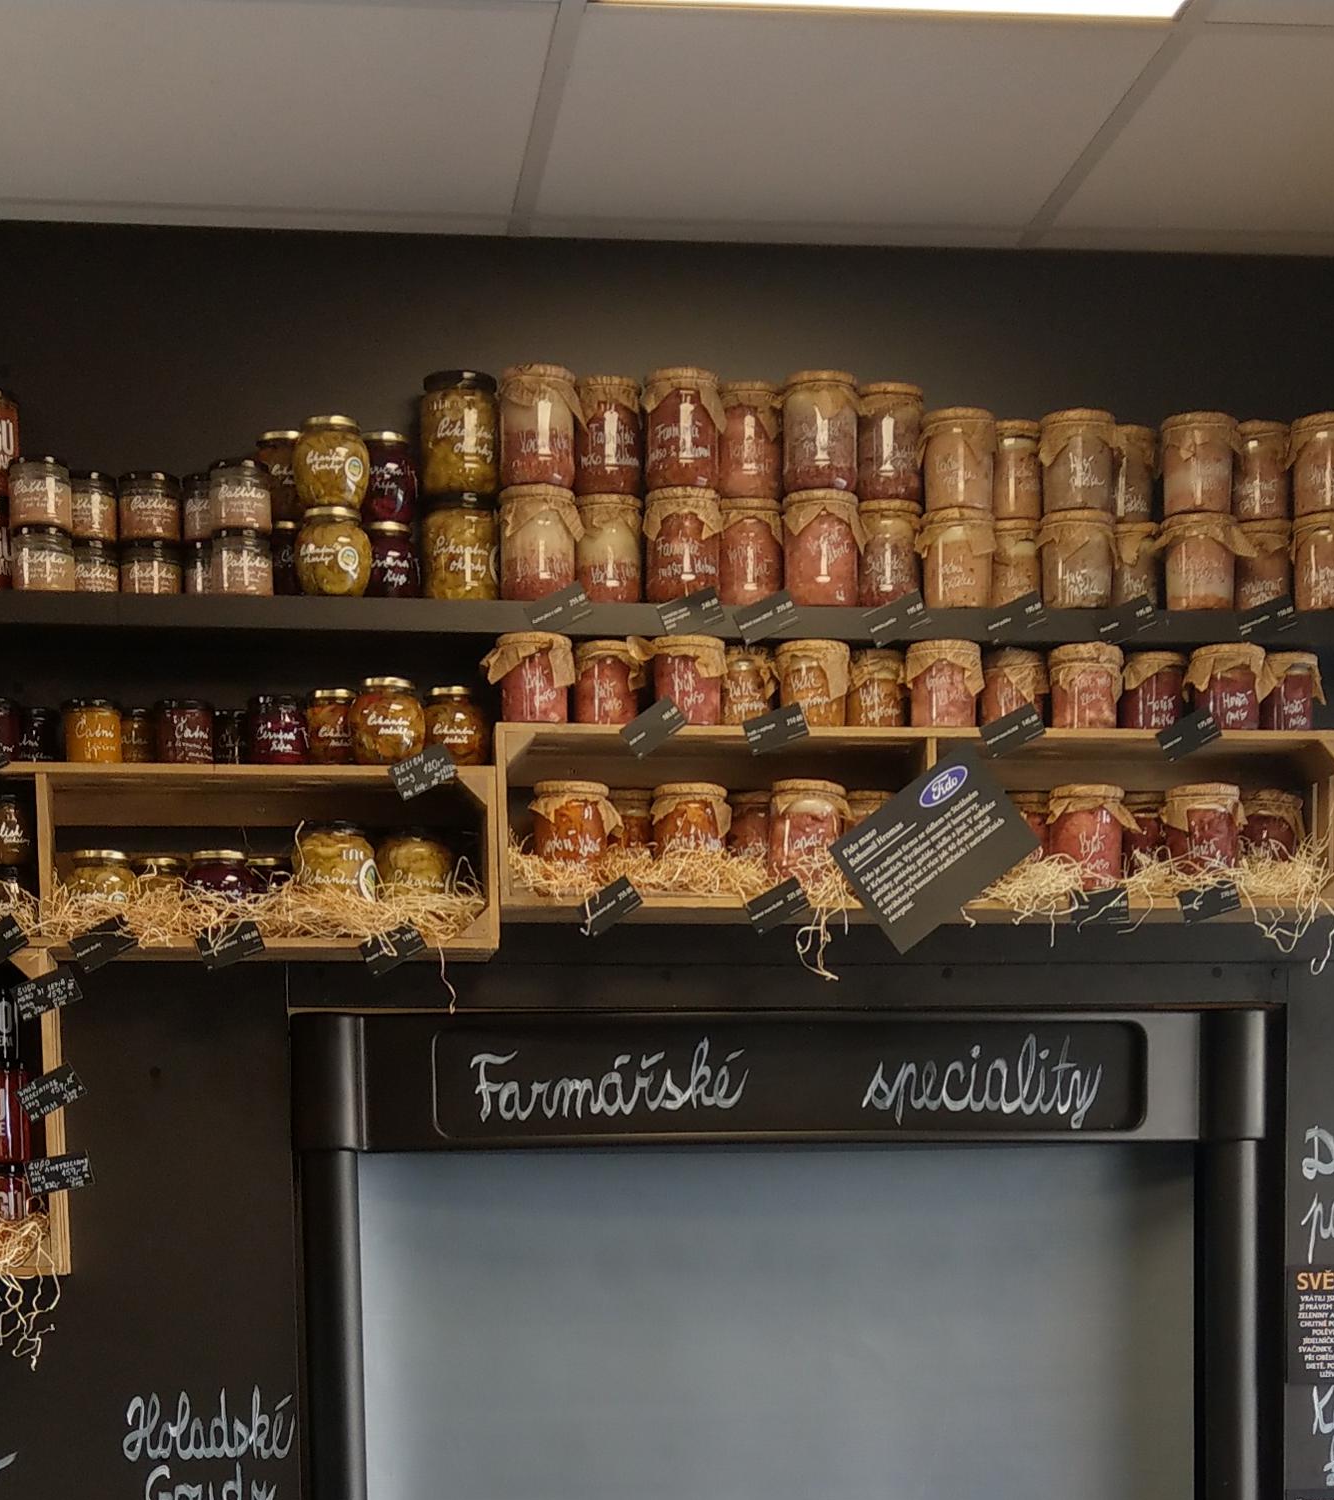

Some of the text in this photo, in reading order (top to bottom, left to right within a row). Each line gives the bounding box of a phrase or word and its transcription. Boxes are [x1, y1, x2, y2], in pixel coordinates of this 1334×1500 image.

[931, 773, 958, 800] Fido
[471, 1033, 1102, 1129] Farmářské speciality
